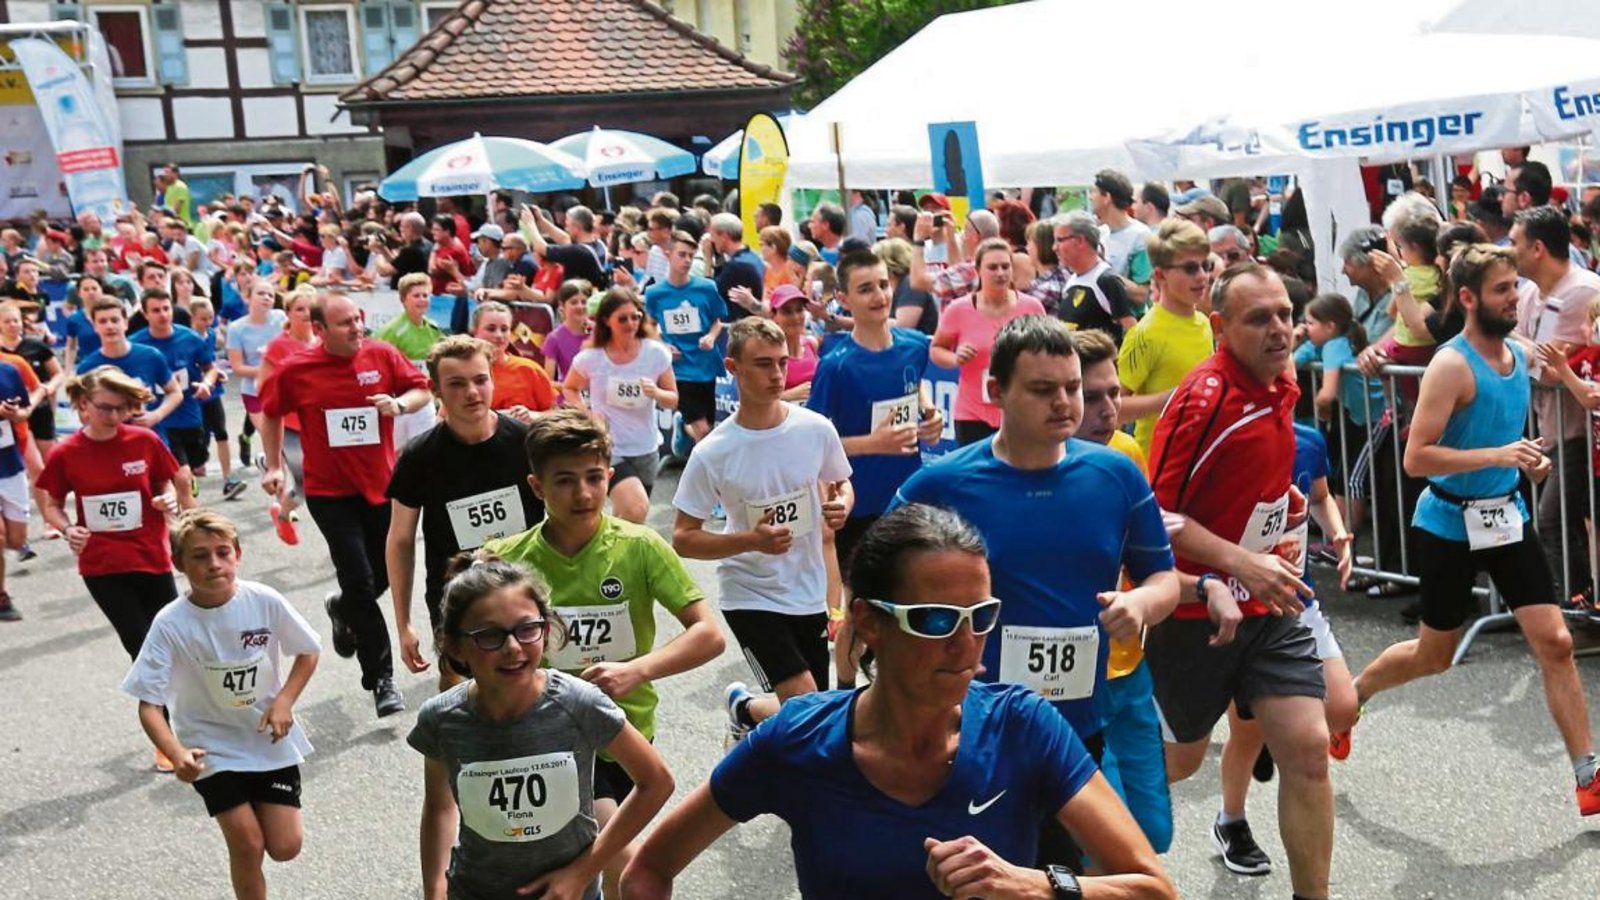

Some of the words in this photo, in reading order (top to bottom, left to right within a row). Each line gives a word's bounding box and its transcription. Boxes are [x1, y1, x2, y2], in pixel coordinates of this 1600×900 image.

[1297, 112, 1482, 149] Ensinger
[598, 169, 643, 183] Ensinger
[430, 183, 479, 193] Ensinger
[673, 313, 690, 325] 531
[617, 384, 640, 398] 583
[341, 415, 367, 432] 475
[888, 405, 910, 426] 53
[99, 501, 127, 518] 476
[467, 501, 507, 528] 556
[568, 618, 612, 646] 472
[1027, 643, 1076, 674] 518
[222, 665, 258, 691] 477
[1051, 687, 1065, 696] GLS
[488, 773, 547, 812] 470
[507, 811, 534, 820] Fiona
[523, 825, 541, 836] GLS
